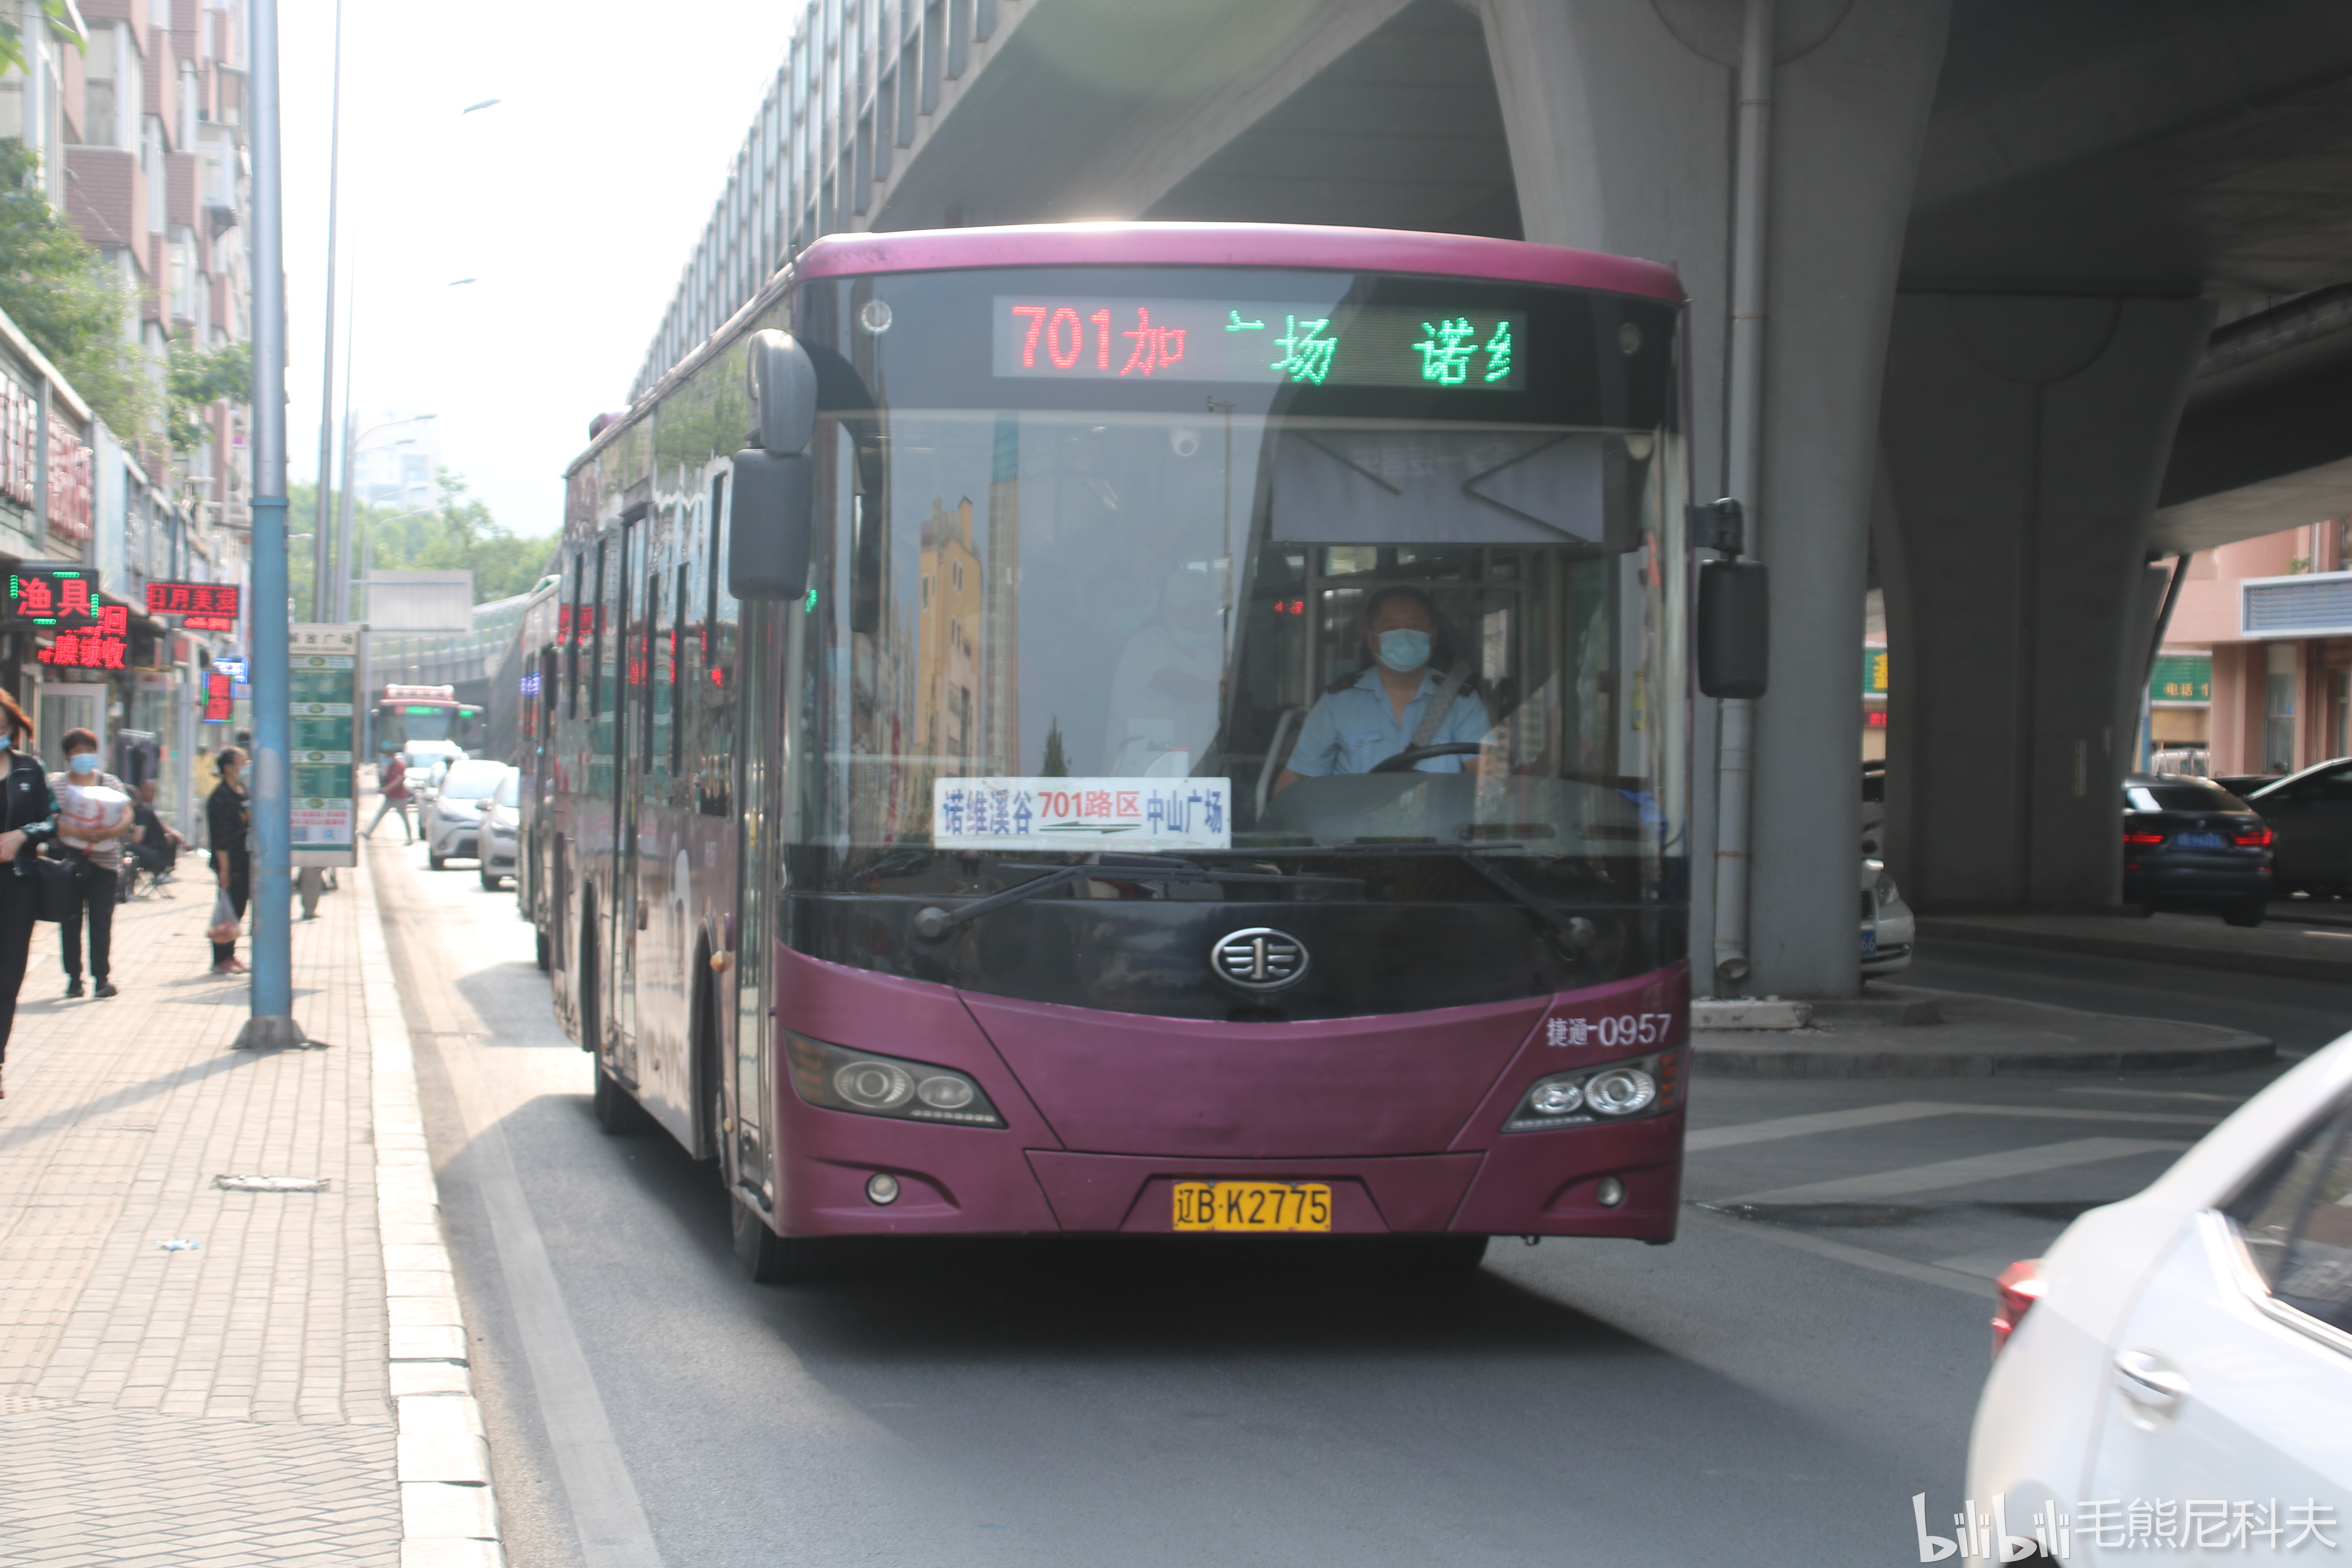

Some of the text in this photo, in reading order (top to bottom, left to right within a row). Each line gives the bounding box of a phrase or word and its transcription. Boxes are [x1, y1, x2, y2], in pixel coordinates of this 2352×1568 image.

[1012, 305, 1186, 376] 701加
[17, 578, 91, 617] 渔具
[2165, 682, 2193, 697] 电话
[943, 789, 1224, 834] 诺维溪谷 701路区 中山广场
[1546, 1013, 1672, 1047] 捷通-0957
[1177, 1189, 1328, 1224] 辽B·K2775
